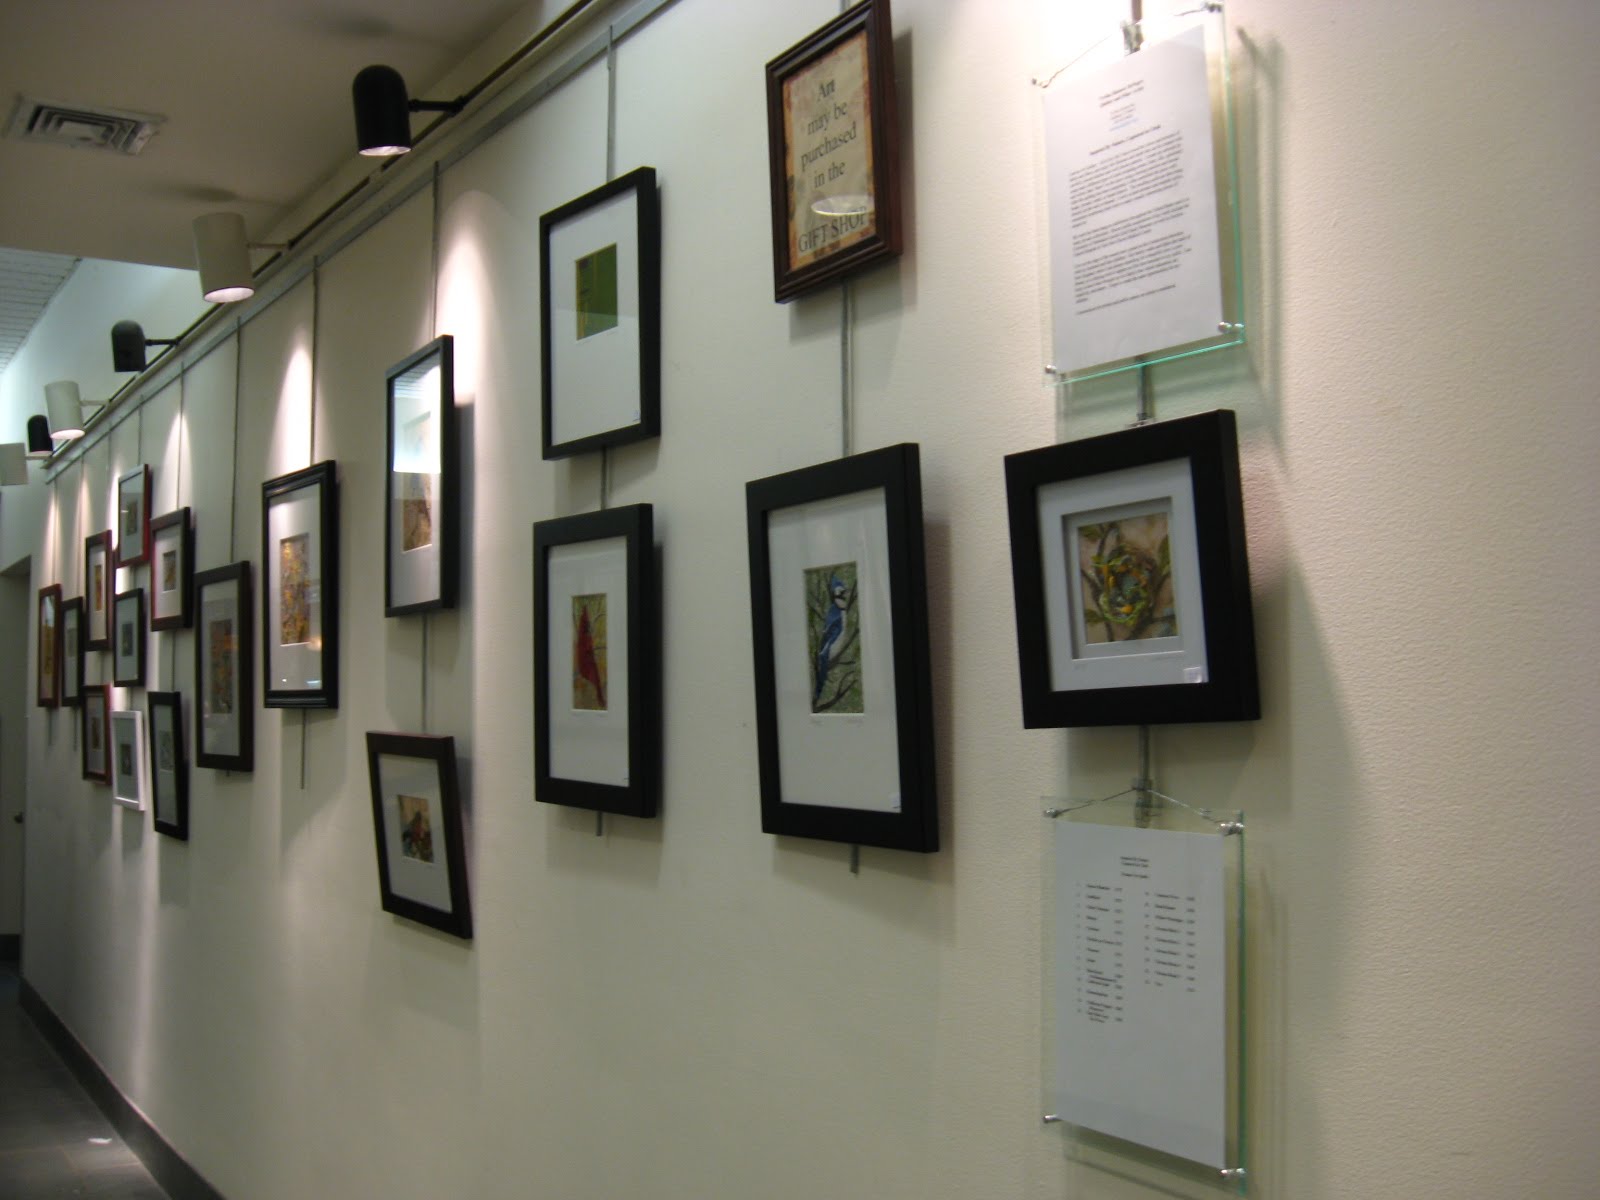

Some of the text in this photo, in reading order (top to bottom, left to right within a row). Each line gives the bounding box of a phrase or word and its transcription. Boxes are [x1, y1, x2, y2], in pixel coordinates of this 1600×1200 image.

[807, 101, 847, 135] may be
[800, 121, 857, 171] purchased
[813, 161, 846, 188] in the
[798, 206, 867, 252] GIFT SHOP
